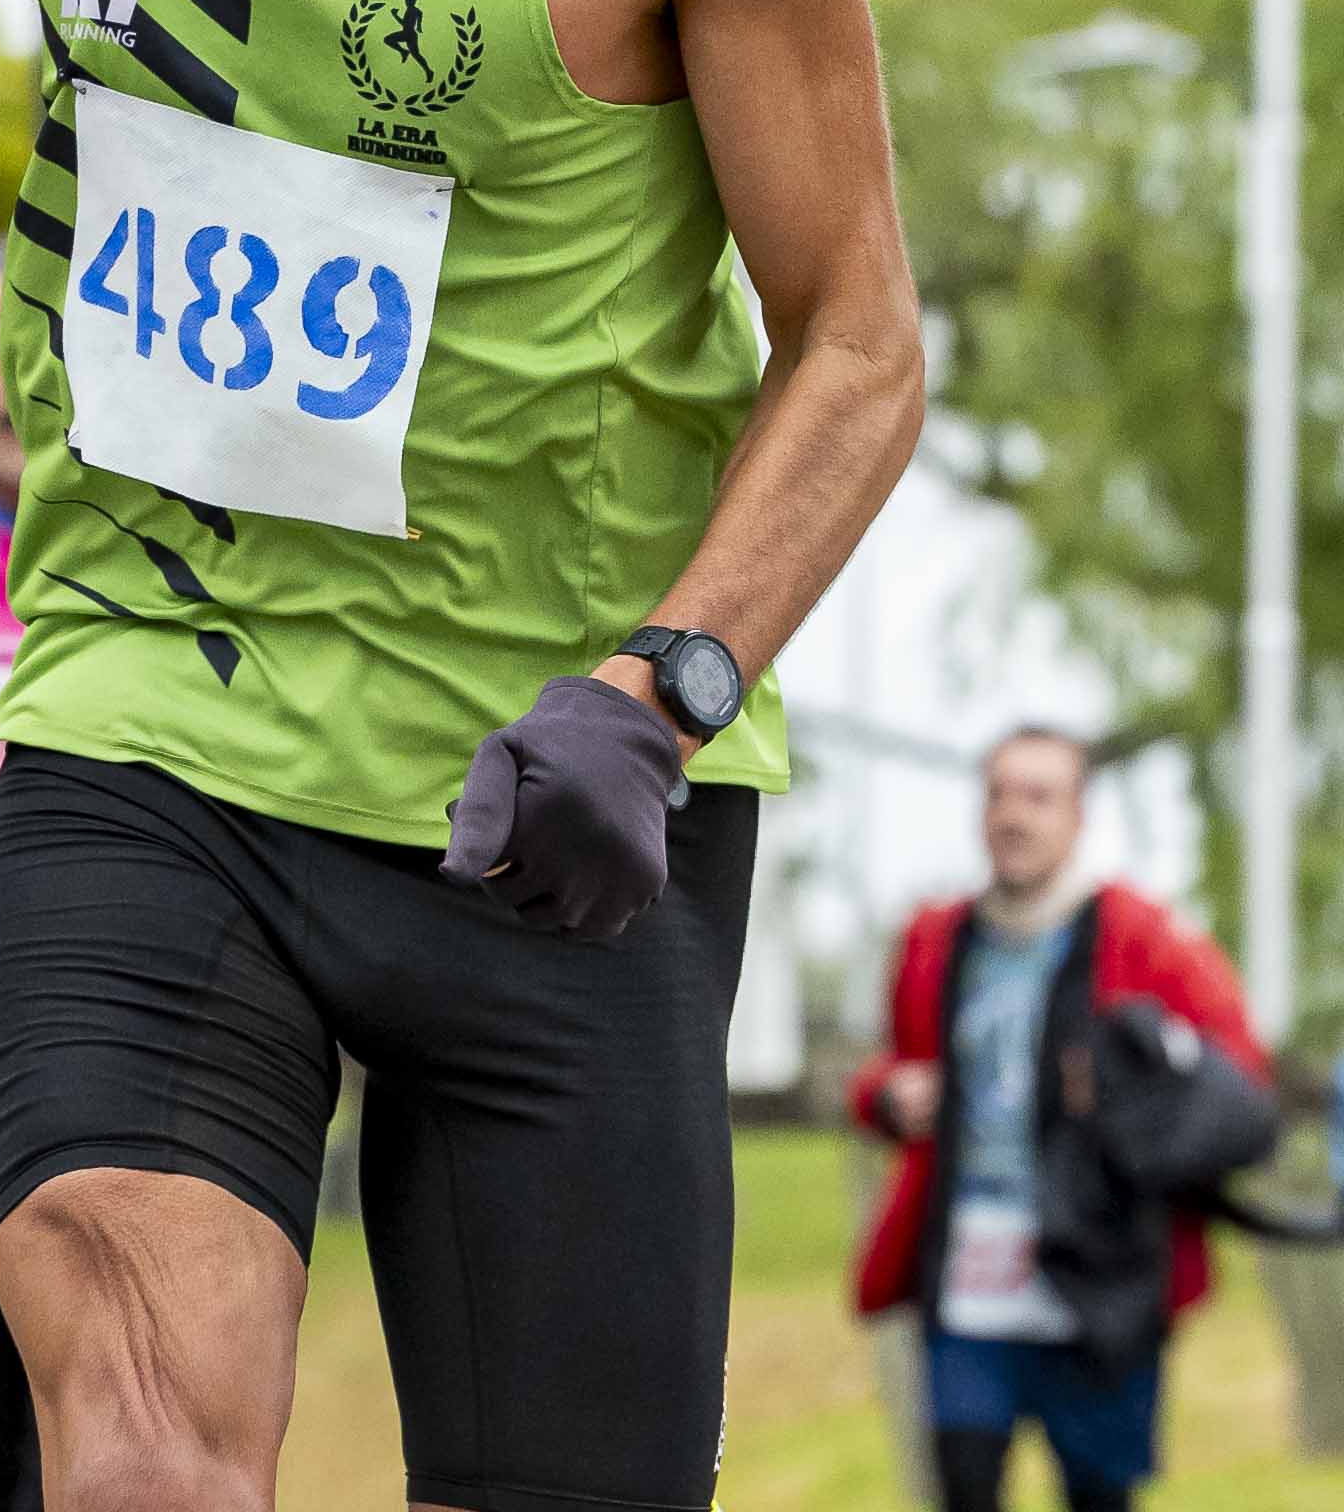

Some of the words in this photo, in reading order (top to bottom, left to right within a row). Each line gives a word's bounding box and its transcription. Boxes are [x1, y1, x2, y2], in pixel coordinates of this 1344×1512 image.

[59, 22, 137, 48] RUNNING
[357, 117, 387, 139] LA
[392, 124, 439, 147] ERA
[79, 207, 412, 420] 489
